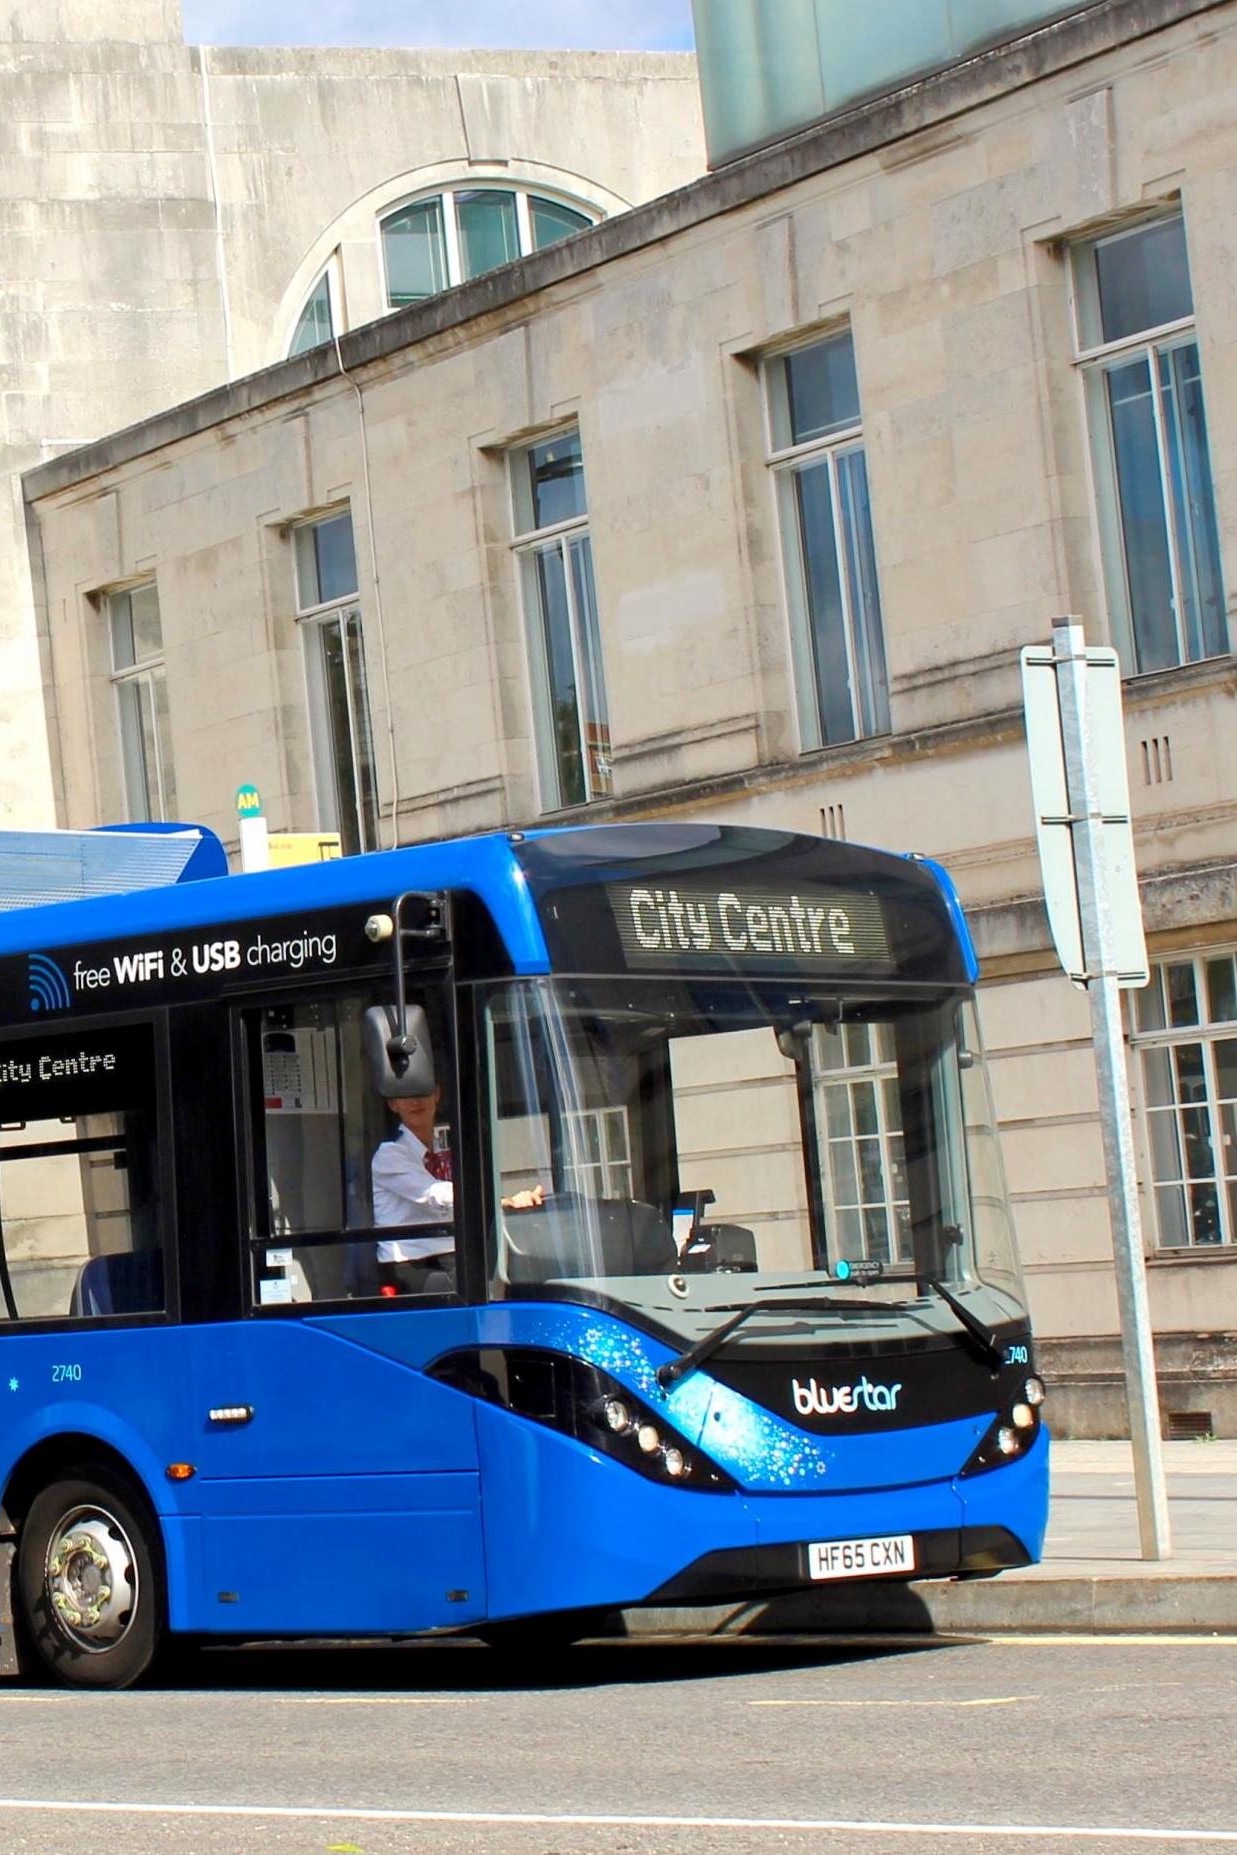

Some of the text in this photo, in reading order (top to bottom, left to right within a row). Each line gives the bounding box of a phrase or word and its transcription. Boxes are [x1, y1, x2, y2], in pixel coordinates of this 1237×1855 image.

[630, 890, 855, 954] City Centre
[73, 930, 336, 991] free WiFi & USB charging
[39, 1051, 116, 1080] Centre
[1005, 1346, 1028, 1364] 740
[52, 1364, 82, 1382] 2740
[818, 1540, 905, 1571] HF65 CXN
